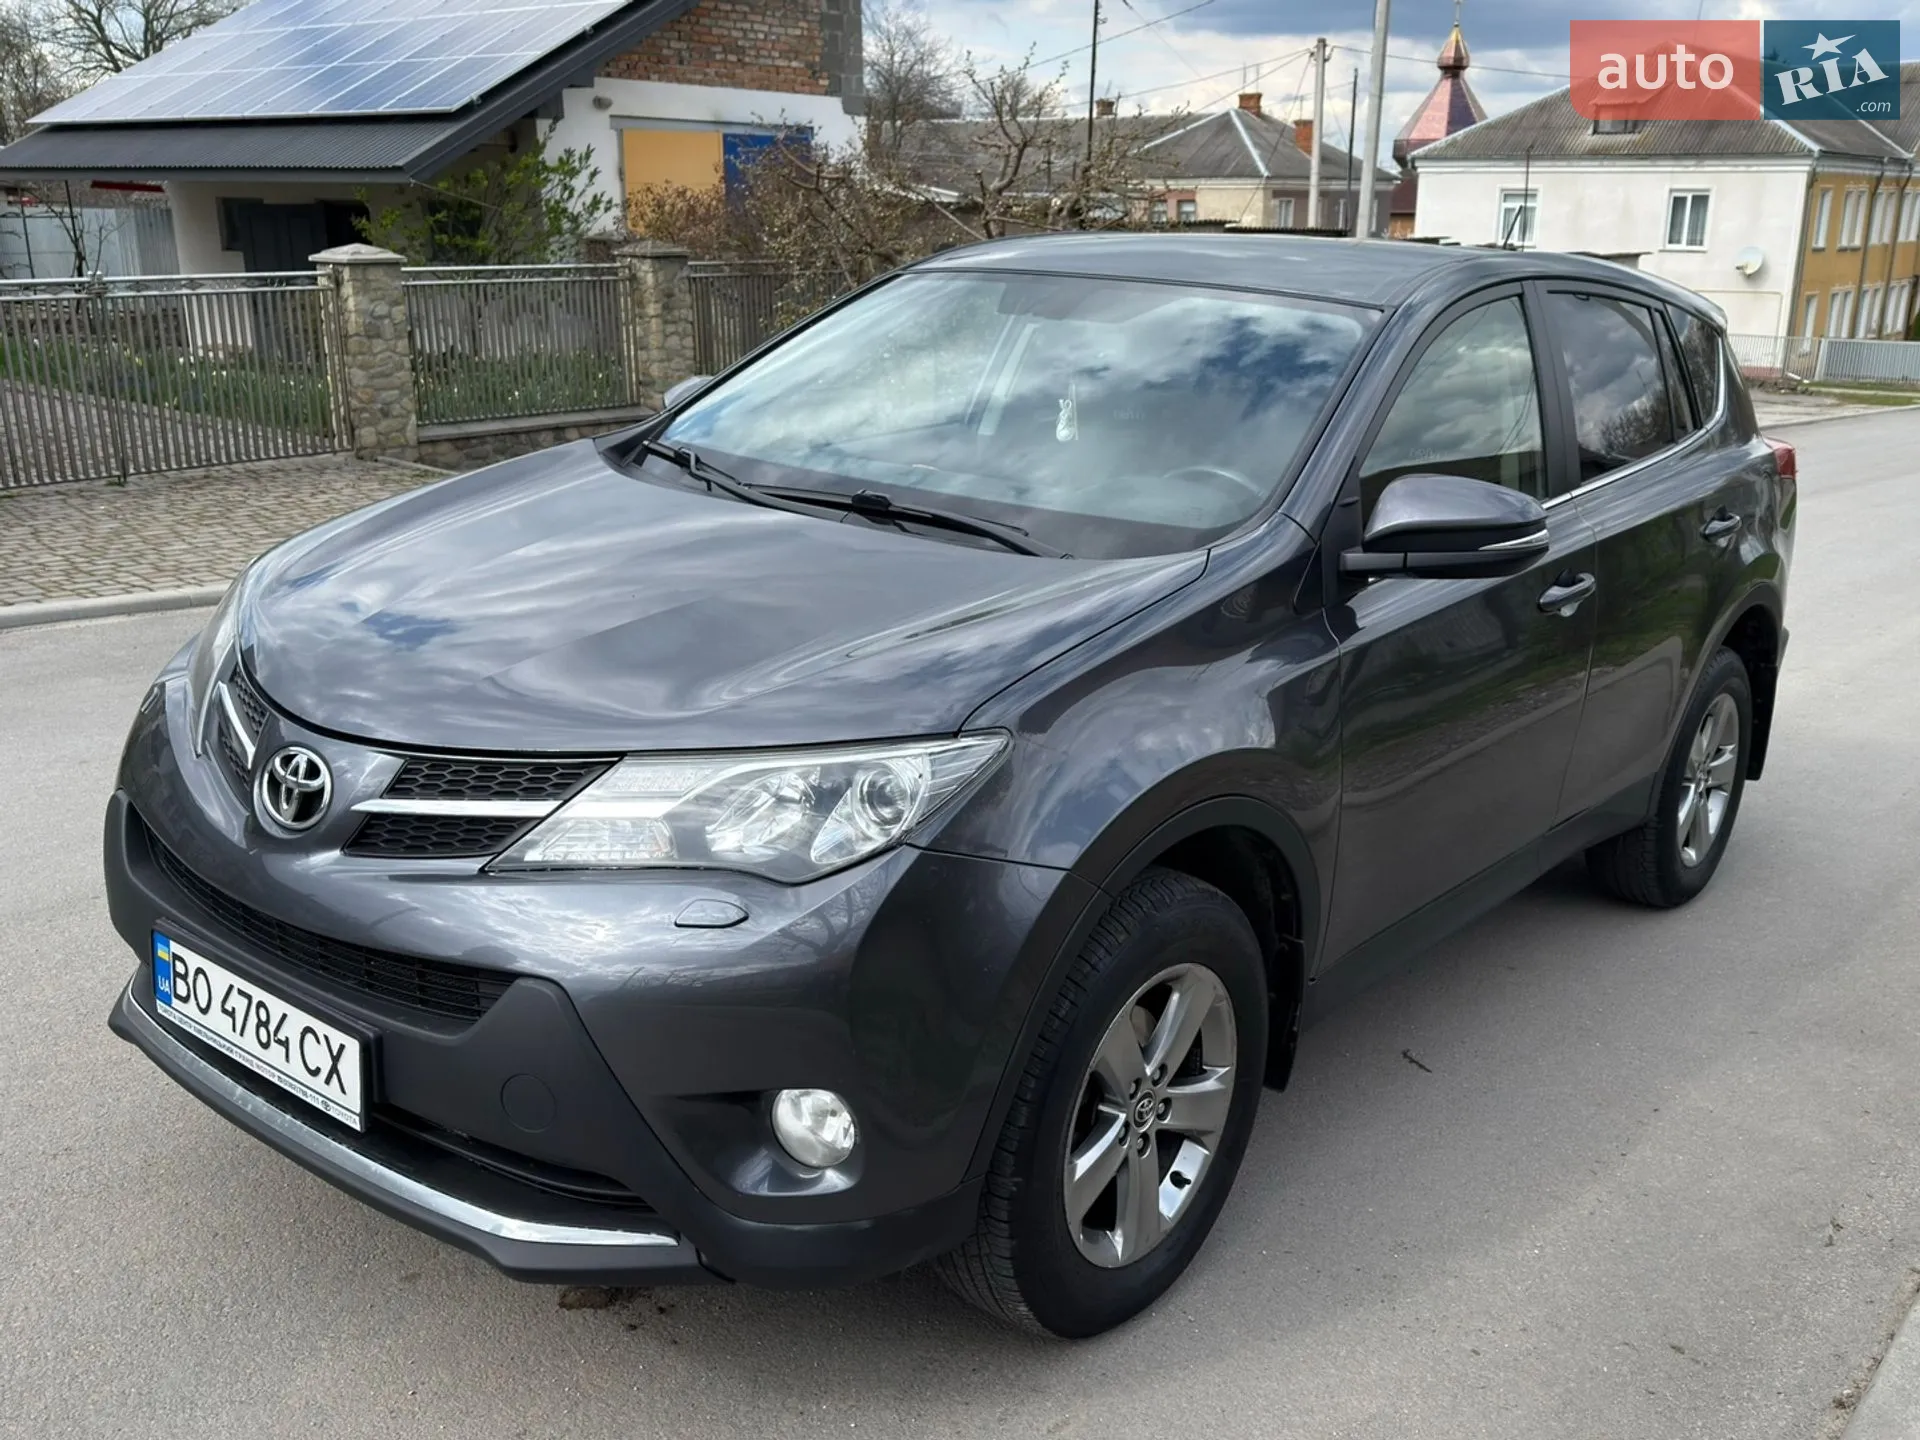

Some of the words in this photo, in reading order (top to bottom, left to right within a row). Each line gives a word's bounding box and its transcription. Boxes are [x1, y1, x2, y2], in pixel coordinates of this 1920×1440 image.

[158, 975, 171, 994] UA
[172, 952, 212, 1016] BO
[221, 984, 290, 1063] 4784
[299, 1025, 347, 1095] CX
